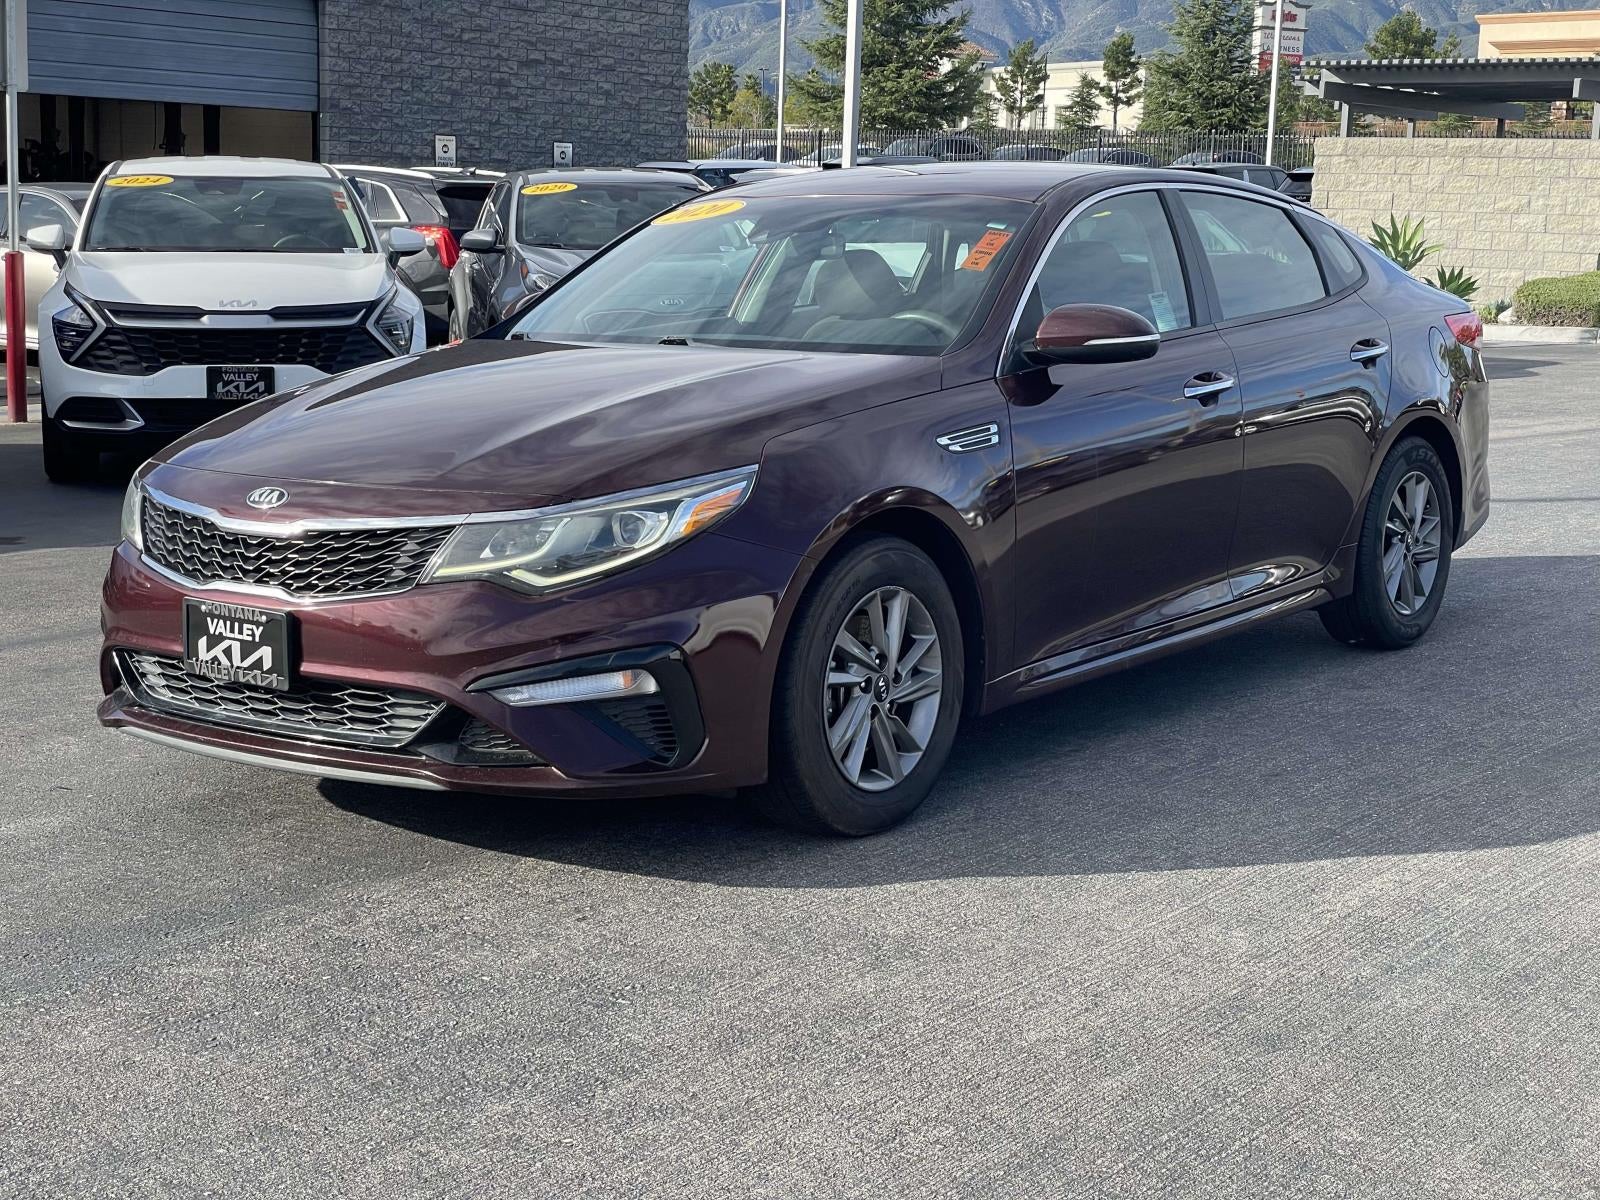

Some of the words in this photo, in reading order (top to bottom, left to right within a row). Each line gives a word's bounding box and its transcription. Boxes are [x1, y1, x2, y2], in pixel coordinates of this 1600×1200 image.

[115, 177, 163, 185] 2024
[531, 184, 568, 193] 2020
[222, 373, 259, 381] VALLEY
[216, 381, 265, 393] KIA
[213, 392, 243, 400] VALLEY
[249, 489, 280, 503] KIA
[205, 601, 263, 621] FONTANA
[206, 617, 264, 642] VALLEY
[198, 635, 272, 672] KIA
[193, 657, 237, 681] VALLEY
[878, 677, 887, 700] KIA
